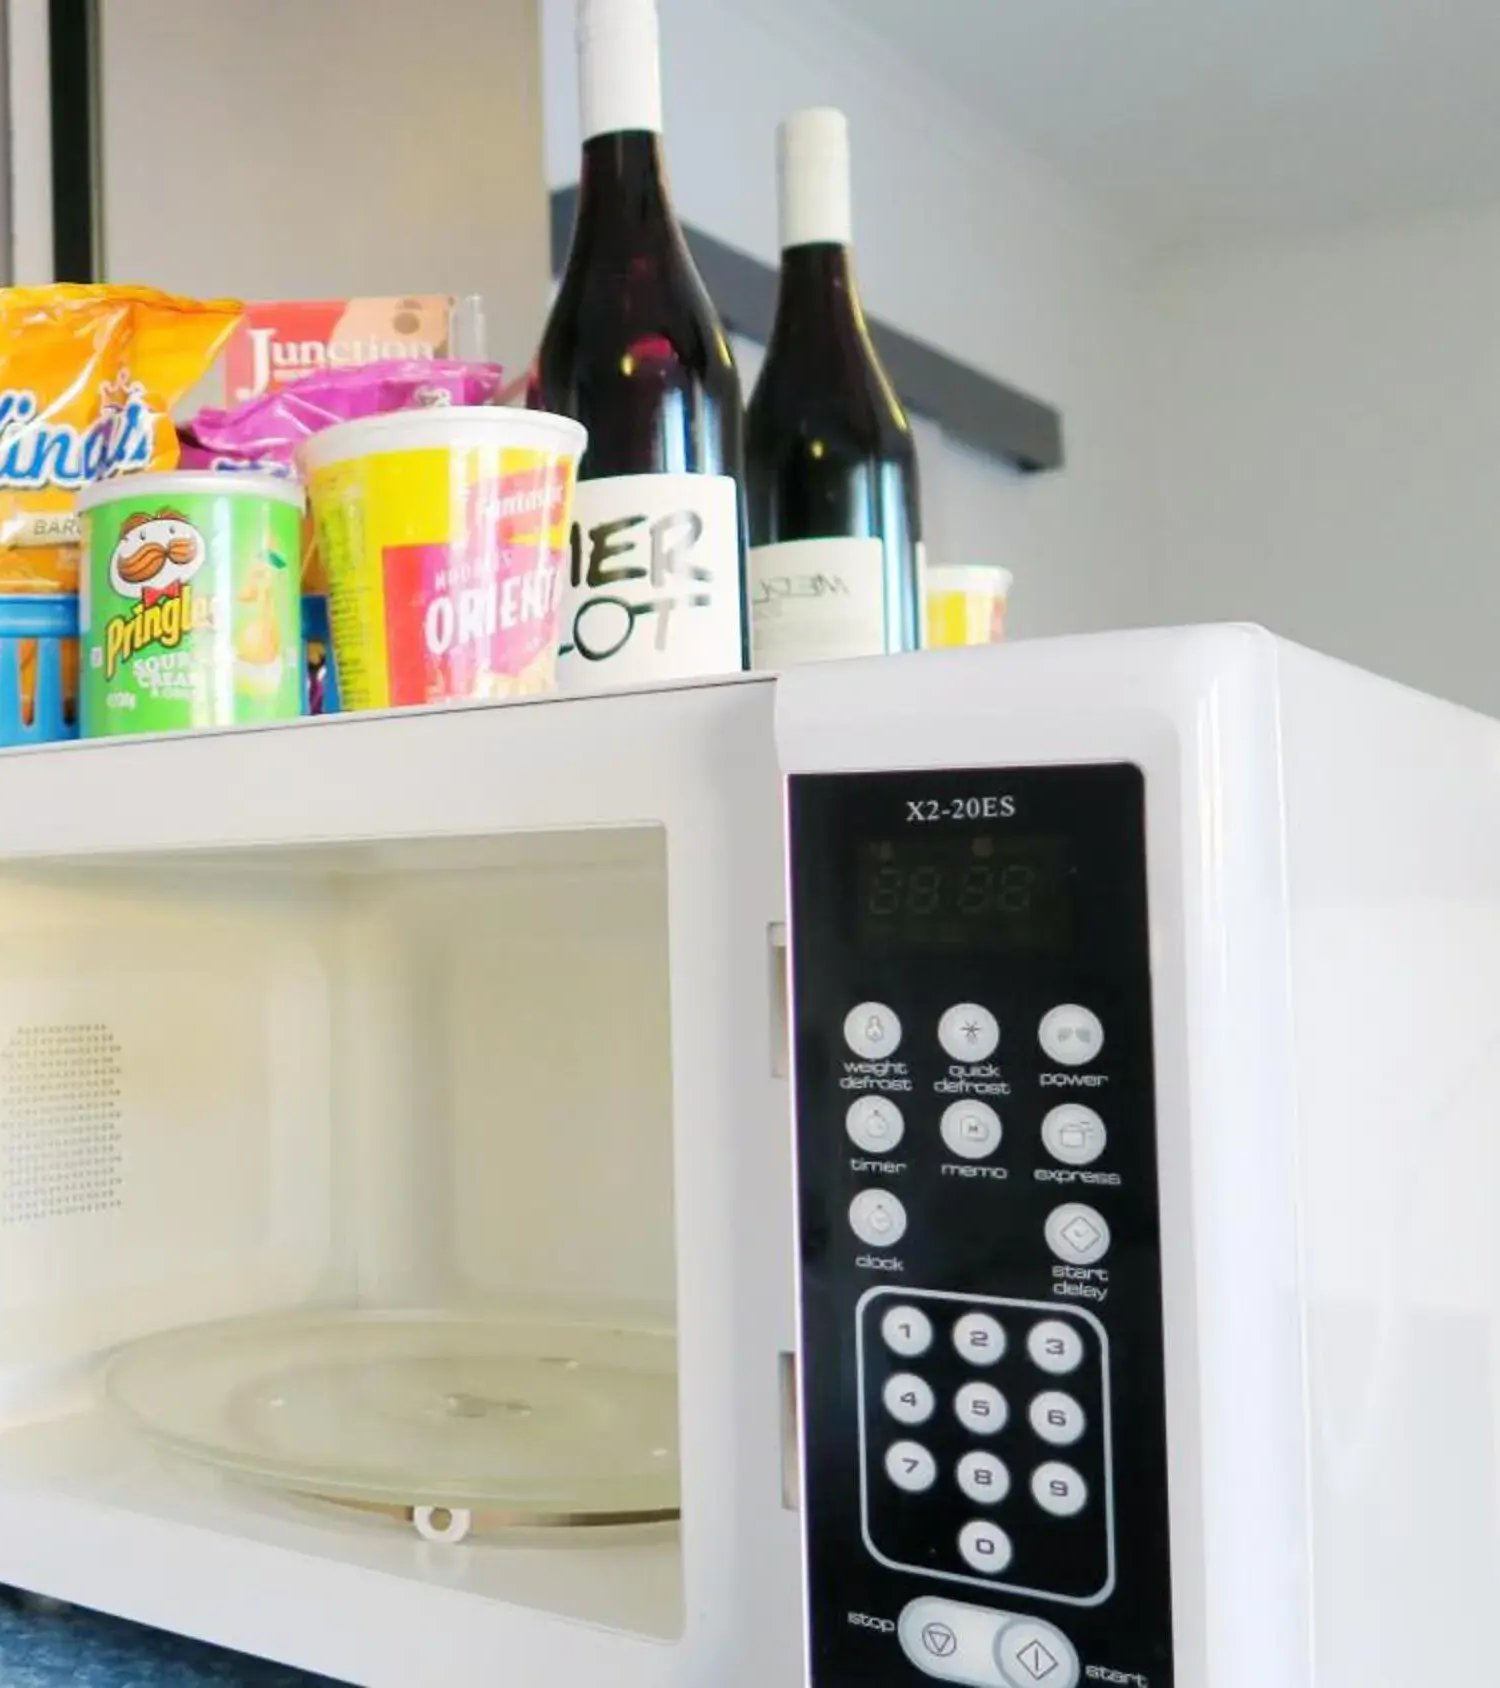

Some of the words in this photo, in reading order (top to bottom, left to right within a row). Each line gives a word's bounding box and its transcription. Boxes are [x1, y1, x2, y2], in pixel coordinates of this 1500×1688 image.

[32, 518, 82, 536] BAR
[570, 510, 712, 588] ER
[557, 594, 711, 662] OT
[905, 794, 1017, 822] X2-20ES
[843, 1060, 908, 1076] weight
[949, 1063, 1001, 1078] quick
[840, 1075, 913, 1092] defrost
[933, 1077, 1012, 1096] defrost
[1038, 1072, 1110, 1088] power
[850, 1156, 908, 1175] timer
[940, 1162, 1008, 1180] memo
[1033, 1167, 1123, 1186] express
[855, 1253, 905, 1273] clock
[1051, 1264, 1109, 1282] start
[1052, 1281, 1108, 1302] delay
[898, 1323, 911, 1339] 1
[969, 1330, 989, 1347] 2
[1045, 1338, 1065, 1356] 3
[899, 1391, 917, 1407] 4
[971, 1400, 990, 1417] 5
[1047, 1409, 1067, 1427] 6
[901, 1457, 919, 1474] 7
[973, 1468, 993, 1486] 8
[1049, 1479, 1069, 1497] 9
[975, 1538, 995, 1555] 0
[847, 1611, 896, 1633] stop
[1085, 1664, 1149, 1688] start
